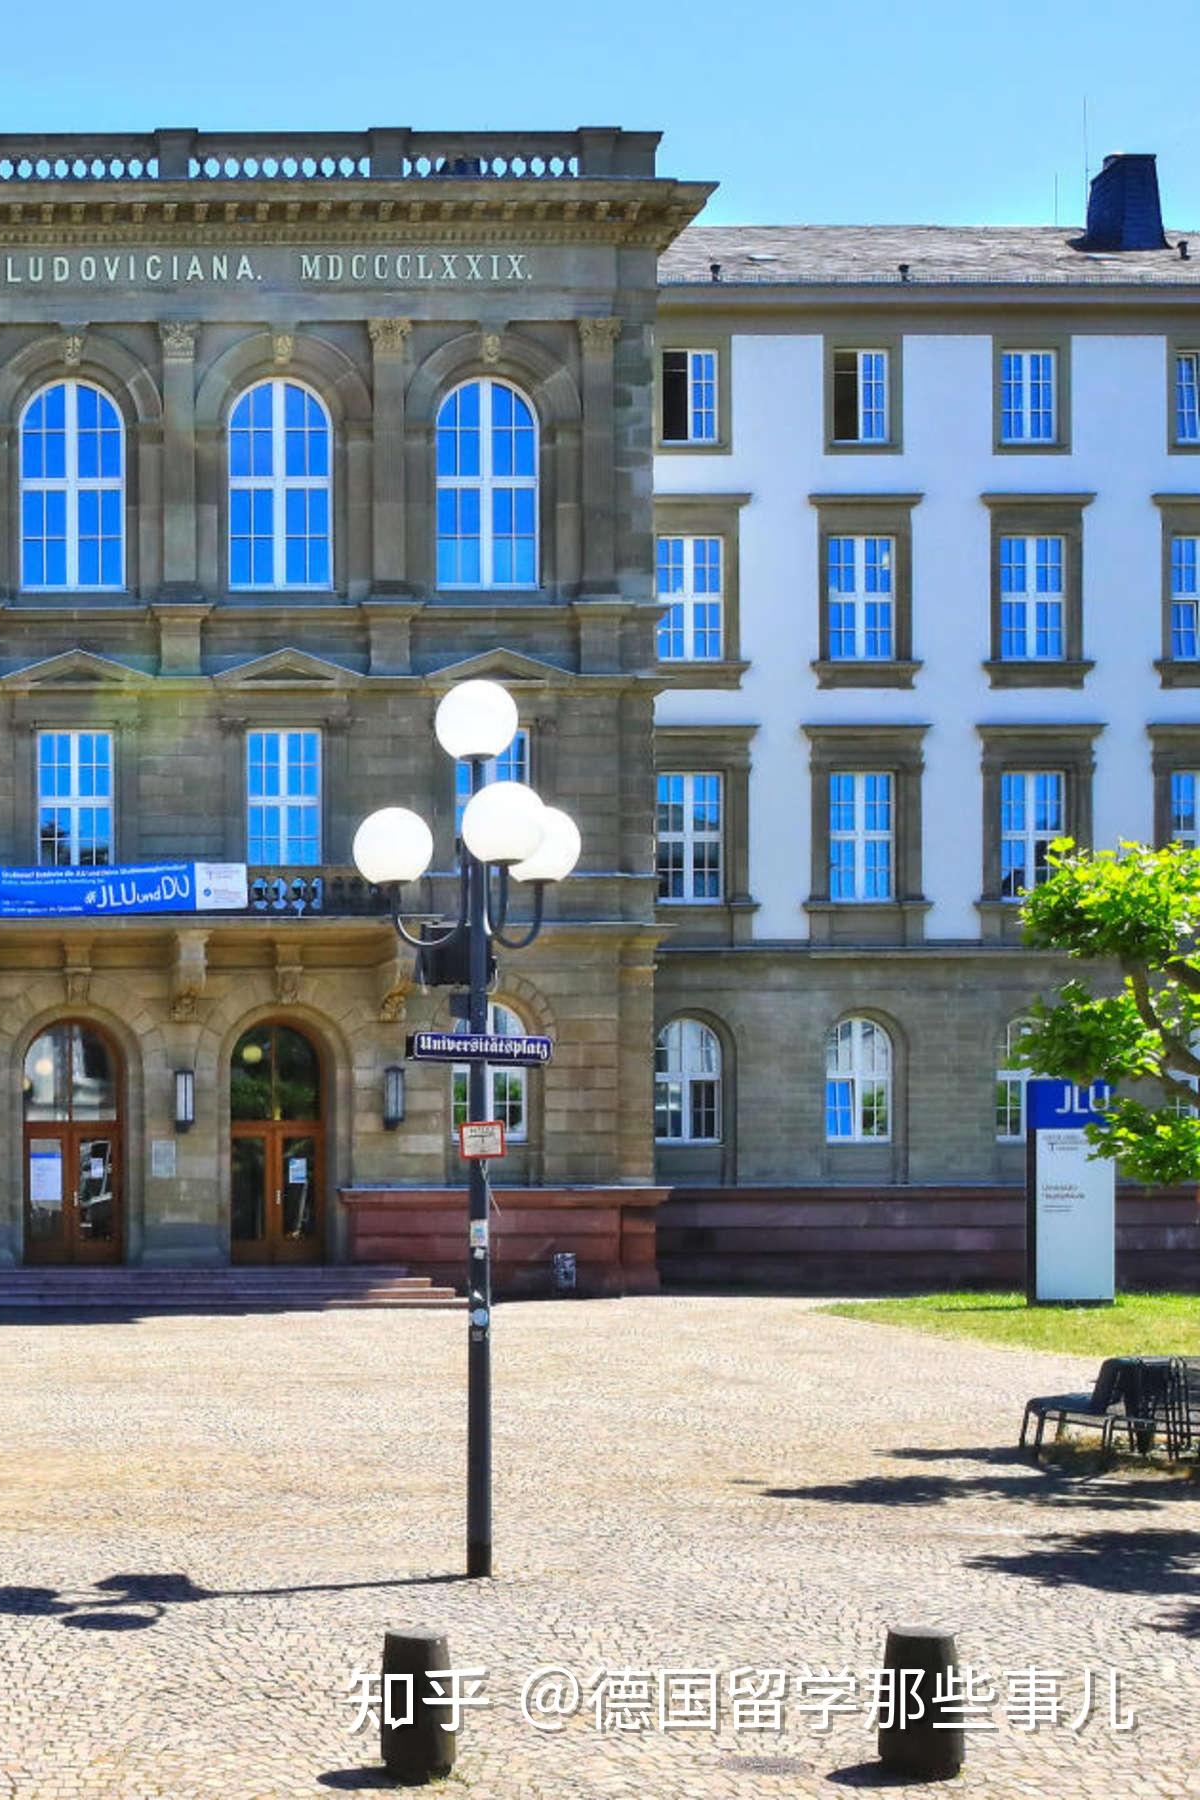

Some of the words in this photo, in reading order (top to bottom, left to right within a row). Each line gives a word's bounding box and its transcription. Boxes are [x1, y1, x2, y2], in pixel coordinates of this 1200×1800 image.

[6, 255, 262, 282] LUDOVICIANA.
[300, 254, 533, 280] MDCCCLXXIX.
[420, 1036, 548, 1059] Universitätsplatz
[1055, 1085, 1110, 1114] JLU
